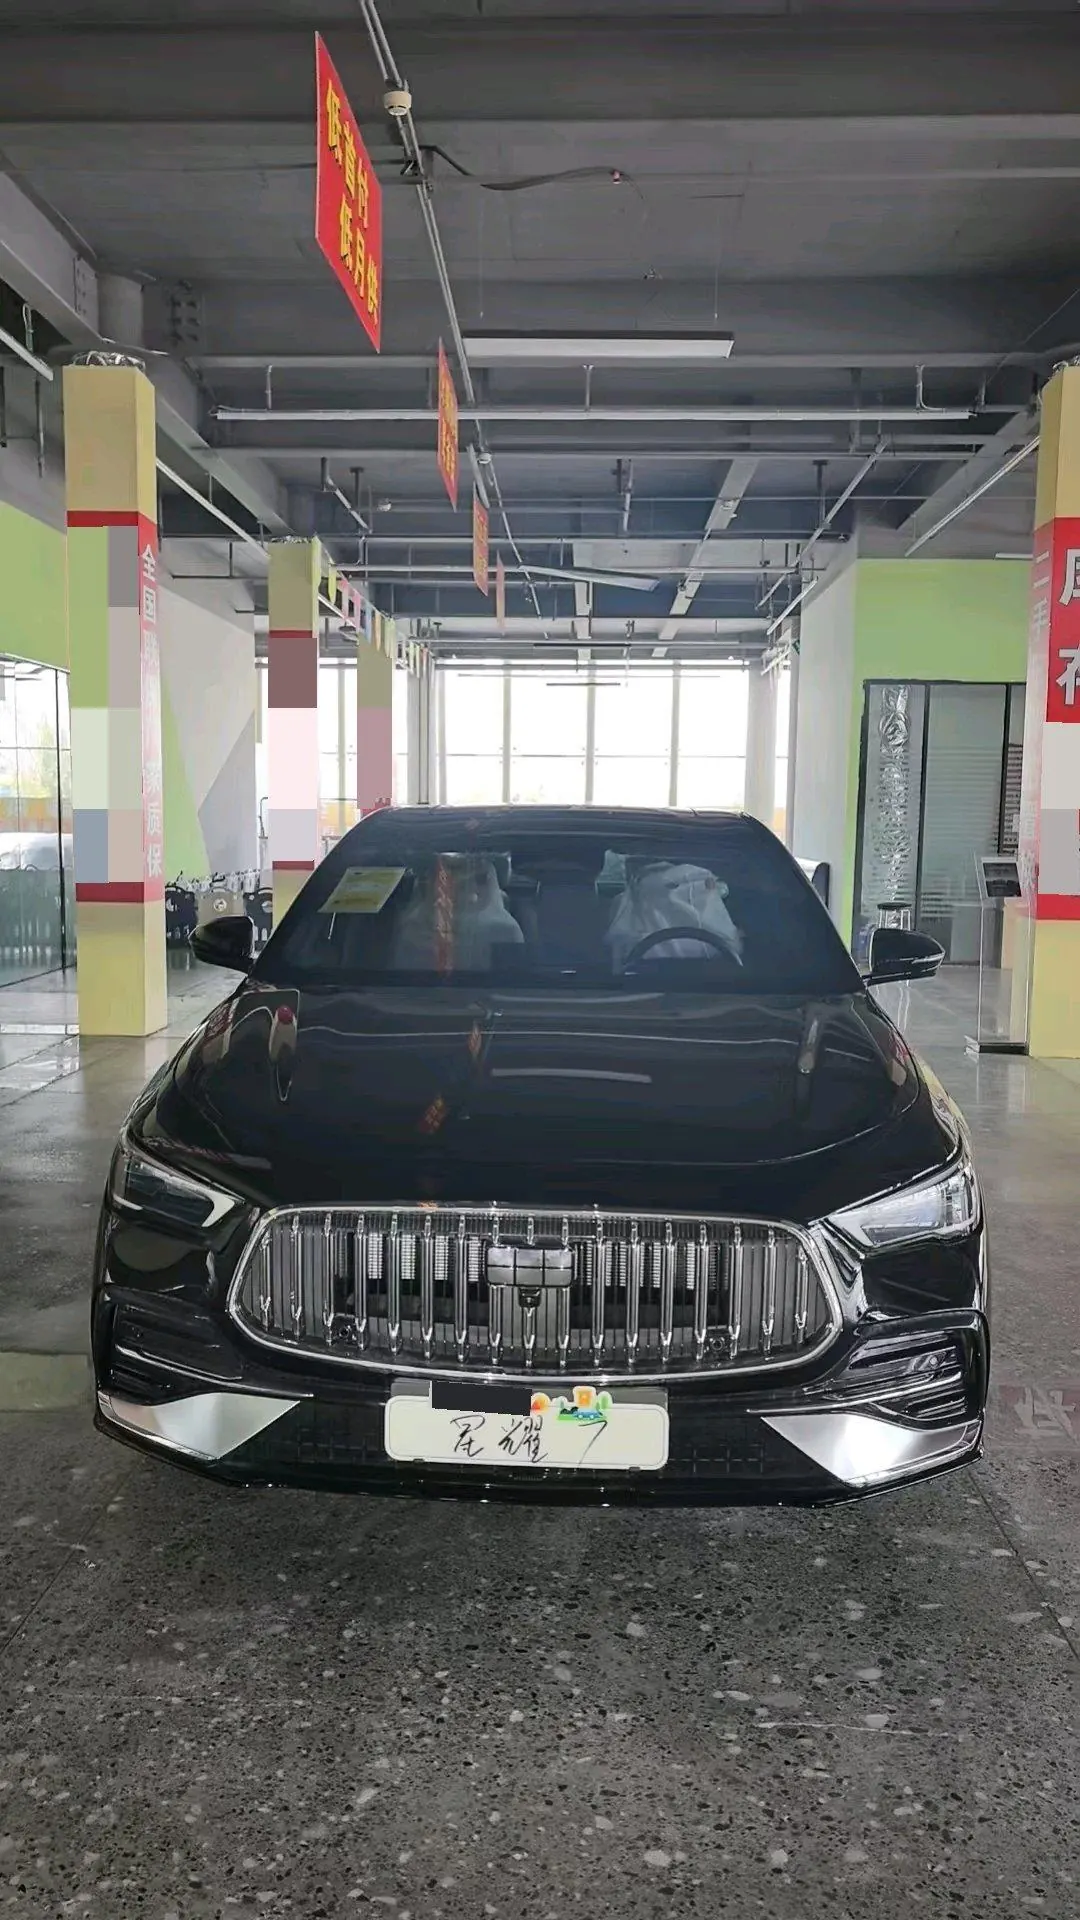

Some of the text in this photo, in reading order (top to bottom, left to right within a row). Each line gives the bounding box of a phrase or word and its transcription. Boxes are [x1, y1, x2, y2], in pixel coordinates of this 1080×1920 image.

[326, 79, 369, 228] 低首付
[340, 192, 378, 324] 低月供
